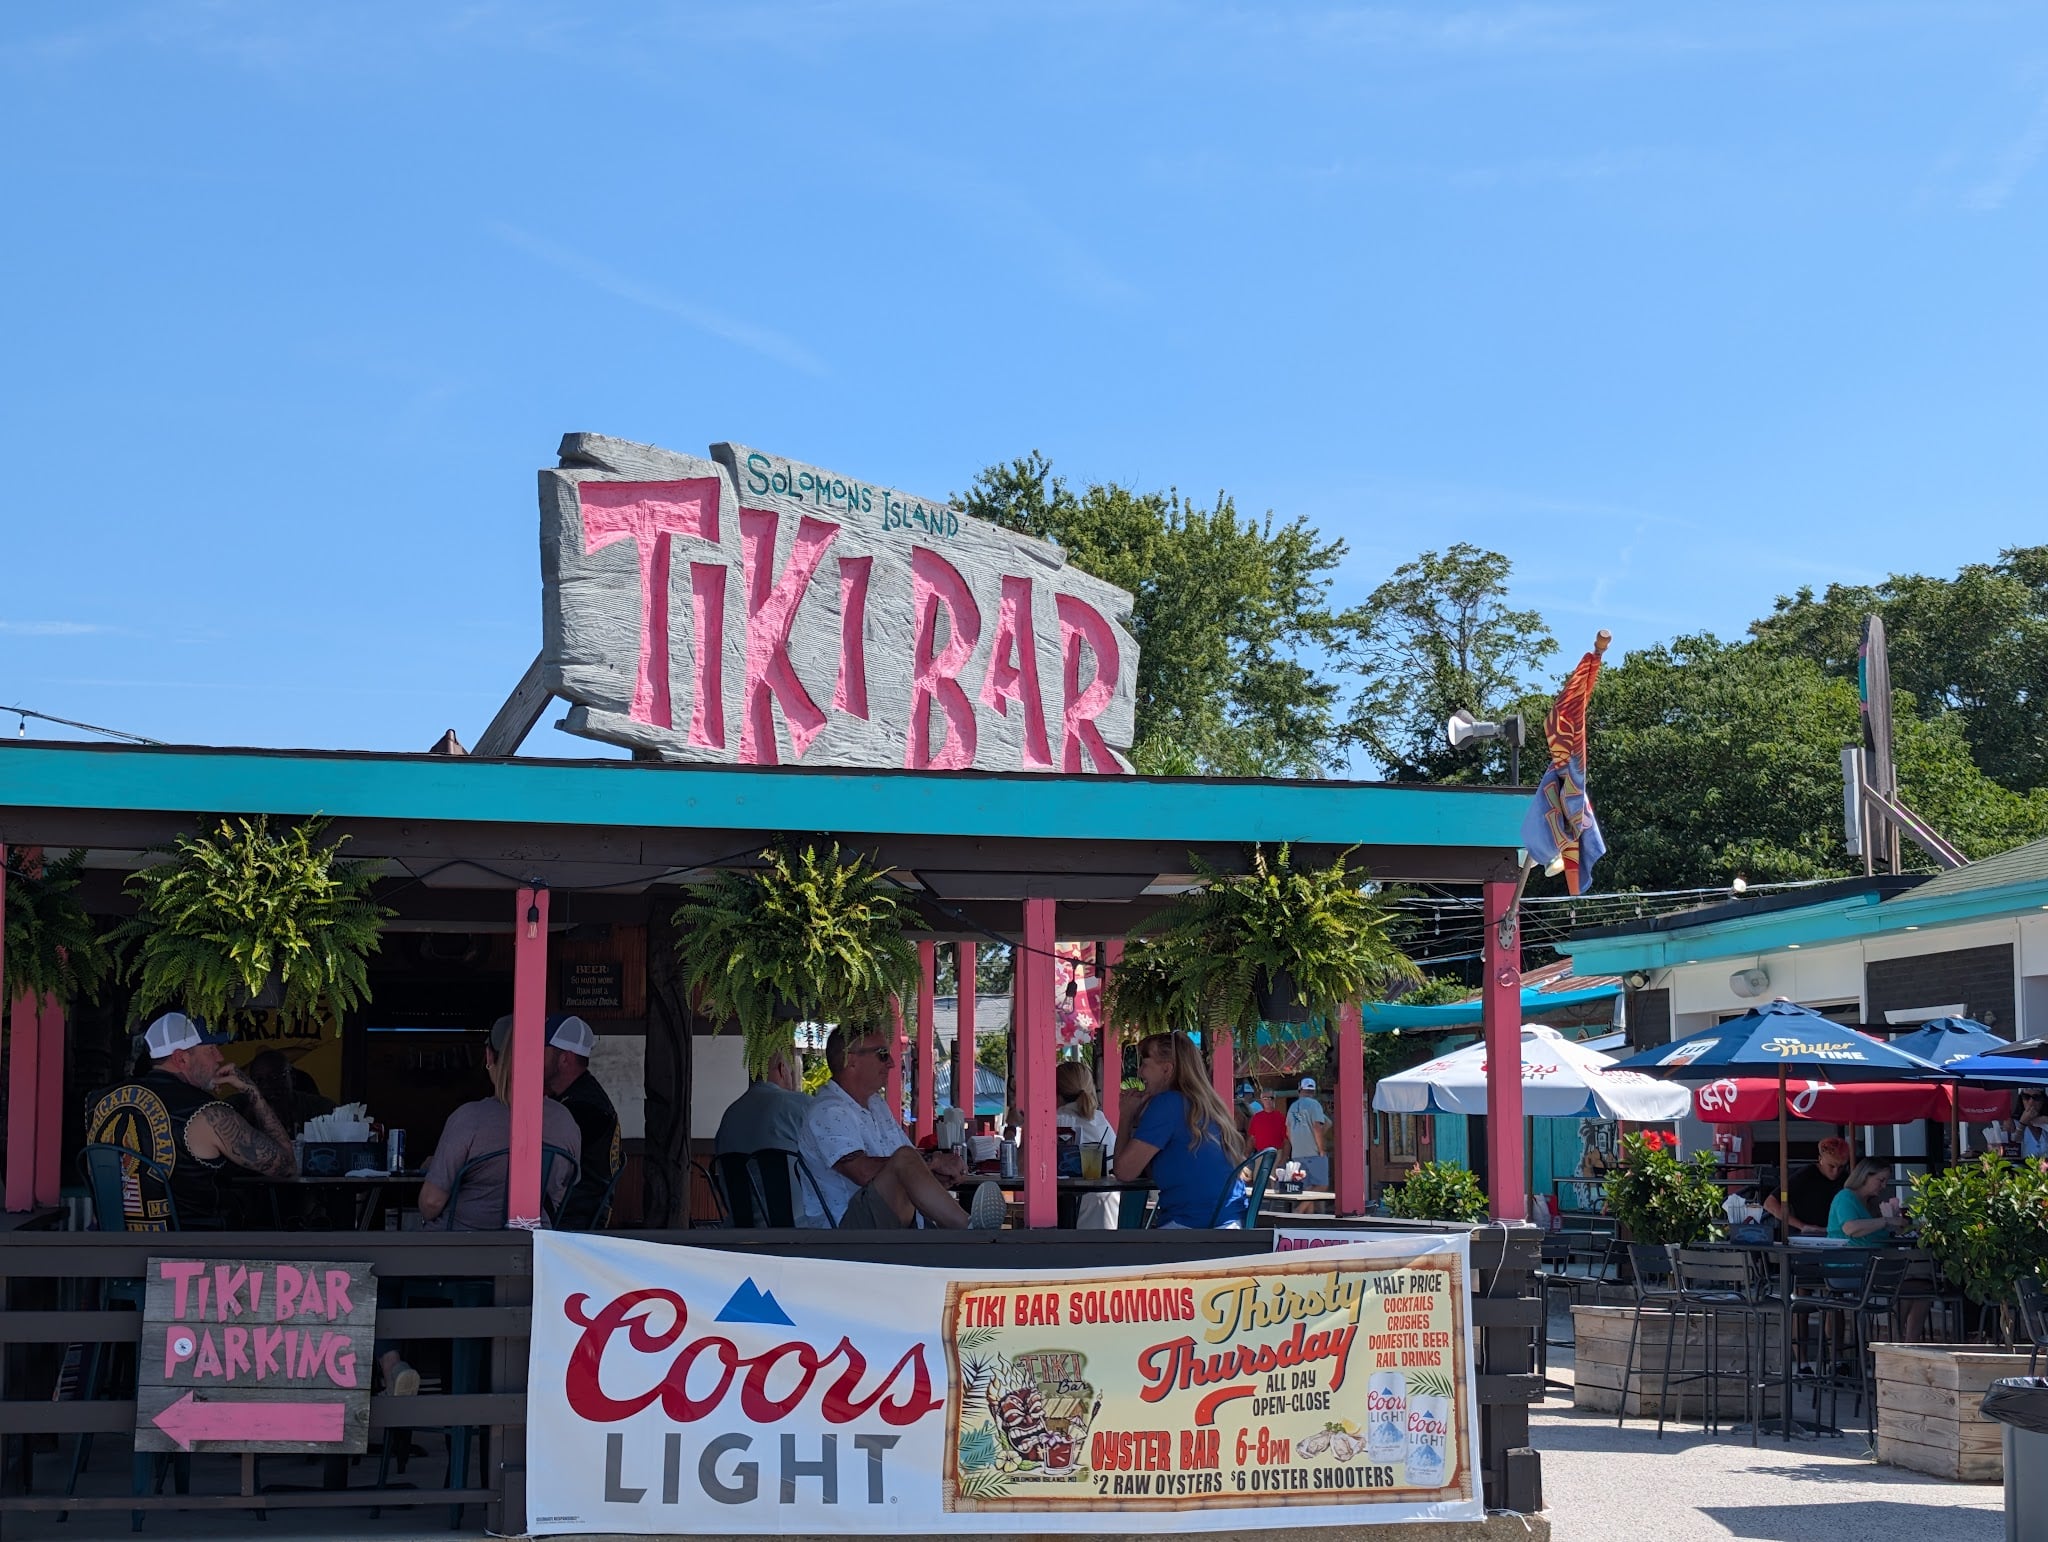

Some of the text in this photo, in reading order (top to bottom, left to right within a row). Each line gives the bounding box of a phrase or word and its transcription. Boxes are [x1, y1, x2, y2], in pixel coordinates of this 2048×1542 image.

[746, 453, 959, 539] SOLOMONS ISLAND
[578, 476, 1125, 775] TIKI BAR
[1760, 1042, 1856, 1057] Miller
[160, 1262, 354, 1323] TIKI BAR
[1373, 1274, 1442, 1294] HALF PRICE
[965, 1287, 1195, 1327] TIKI BAR SOLOMONS
[1201, 1272, 1367, 1344] Thirsty
[1383, 1296, 1434, 1313] COCKTAILS
[1387, 1314, 1430, 1331] CRUSHES
[1369, 1332, 1449, 1350] DOMESTIC BEER
[164, 1325, 358, 1388] PARKING
[564, 1288, 945, 1426] Coors
[1019, 1354, 1082, 1384] TIKI
[1138, 1322, 1359, 1404] Thursday
[1376, 1351, 1441, 1368] RAIL DRINKS
[1056, 1379, 1089, 1394] Bar
[1266, 1370, 1316, 1394] ALL DAY
[1253, 1391, 1330, 1417] OPEN-CLOSE
[1370, 1411, 1404, 1423] LIGHT
[1091, 1430, 1172, 1472] OYSTER
[1180, 1429, 1220, 1470] BAR
[1409, 1434, 1445, 1446] LIGHT
[604, 1432, 902, 1504] LIGHT
[1231, 1472, 1246, 1491] $6
[1251, 1469, 1308, 1491] OYSTER
[1313, 1465, 1394, 1489] SHOOTERS
[1093, 1472, 1222, 1495] $2 RAW OYSTERS
